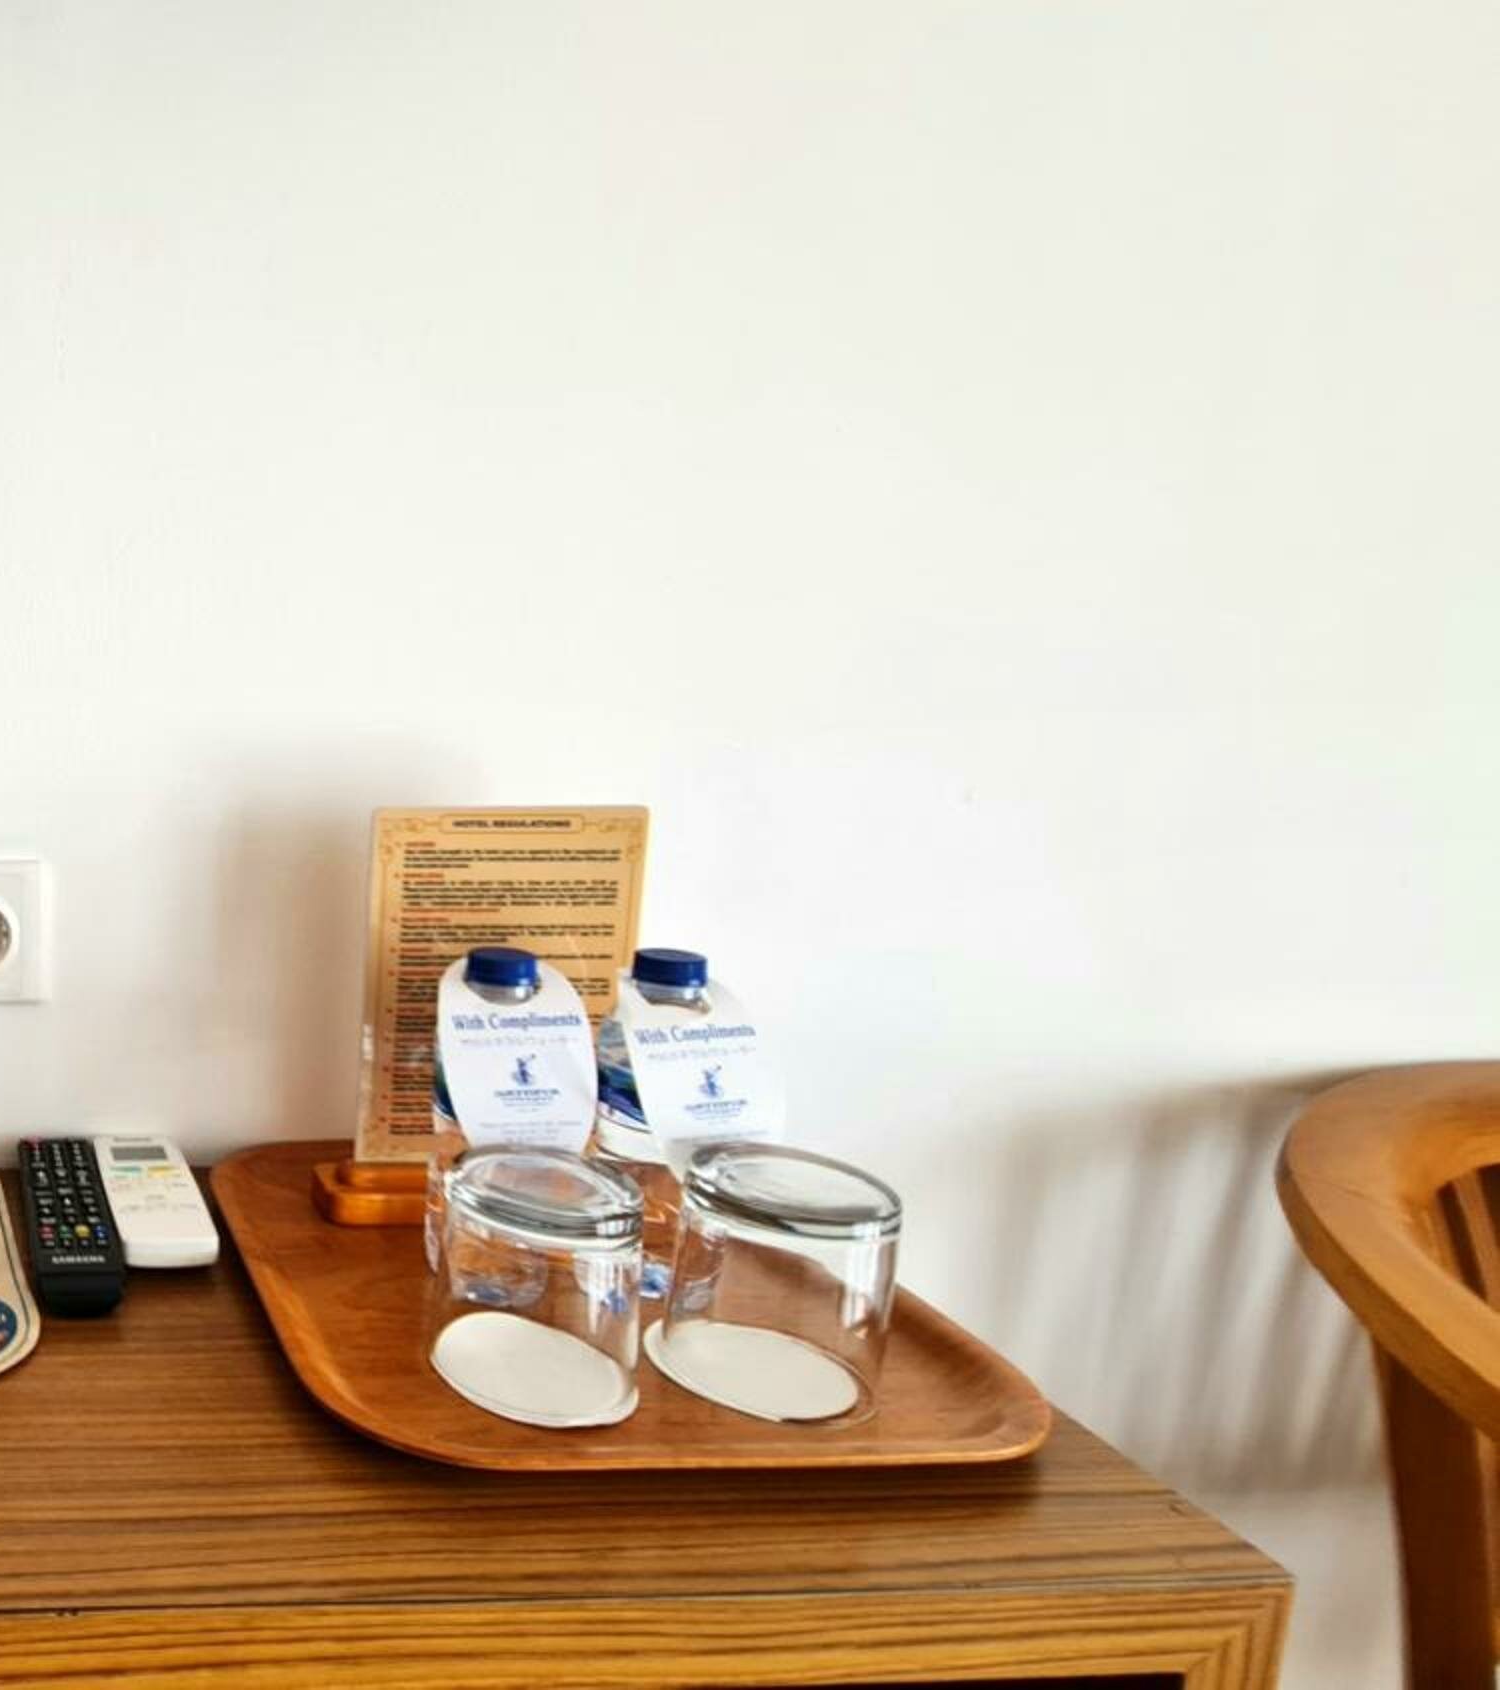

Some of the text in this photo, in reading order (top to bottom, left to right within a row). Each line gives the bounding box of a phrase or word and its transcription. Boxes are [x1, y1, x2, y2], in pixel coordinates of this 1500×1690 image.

[453, 819, 488, 829] HOTEL
[451, 1015, 485, 1030] With
[488, 1012, 582, 1031] Compliments
[633, 1024, 756, 1044] With Compliments
